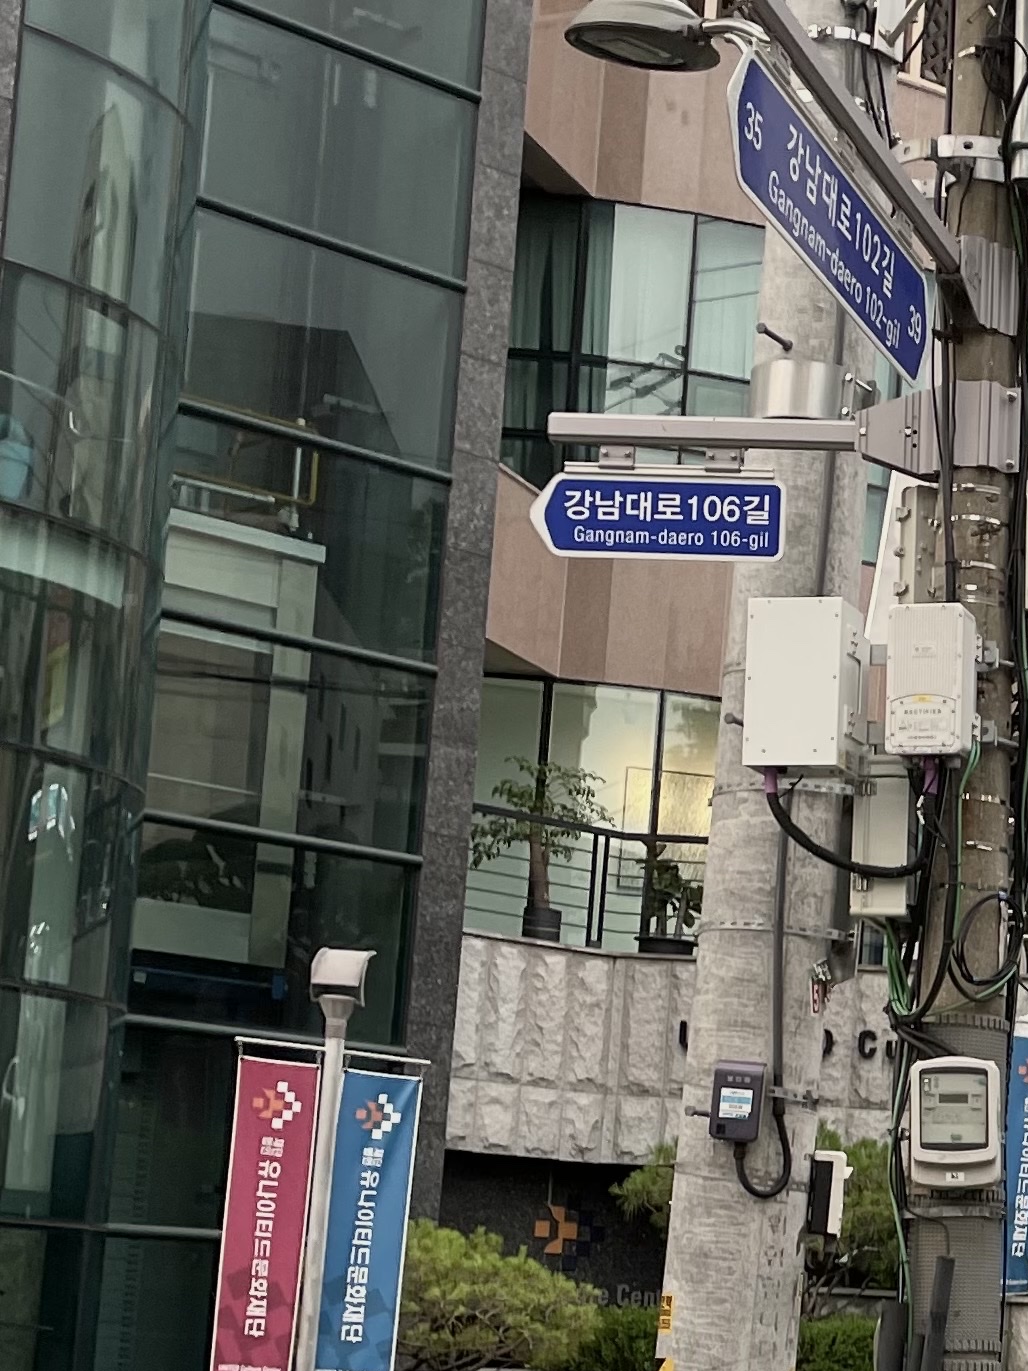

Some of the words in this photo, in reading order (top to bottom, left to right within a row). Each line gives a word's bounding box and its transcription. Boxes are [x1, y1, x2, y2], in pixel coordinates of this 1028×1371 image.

[744, 102, 763, 151] 35
[768, 170, 863, 304] Gangnam-daero
[865, 286, 901, 350] 102-gil
[787, 124, 895, 299] 강남대로102길
[907, 304, 922, 345] 39
[563, 489, 770, 526] 강남대로106길
[573, 526, 704, 547] Gangnam-daero
[710, 530, 769, 551] 106-gil
[244, 1159, 283, 1338] 유나이티드문화재단
[340, 1170, 380, 1344] 유나이티드문화재단
